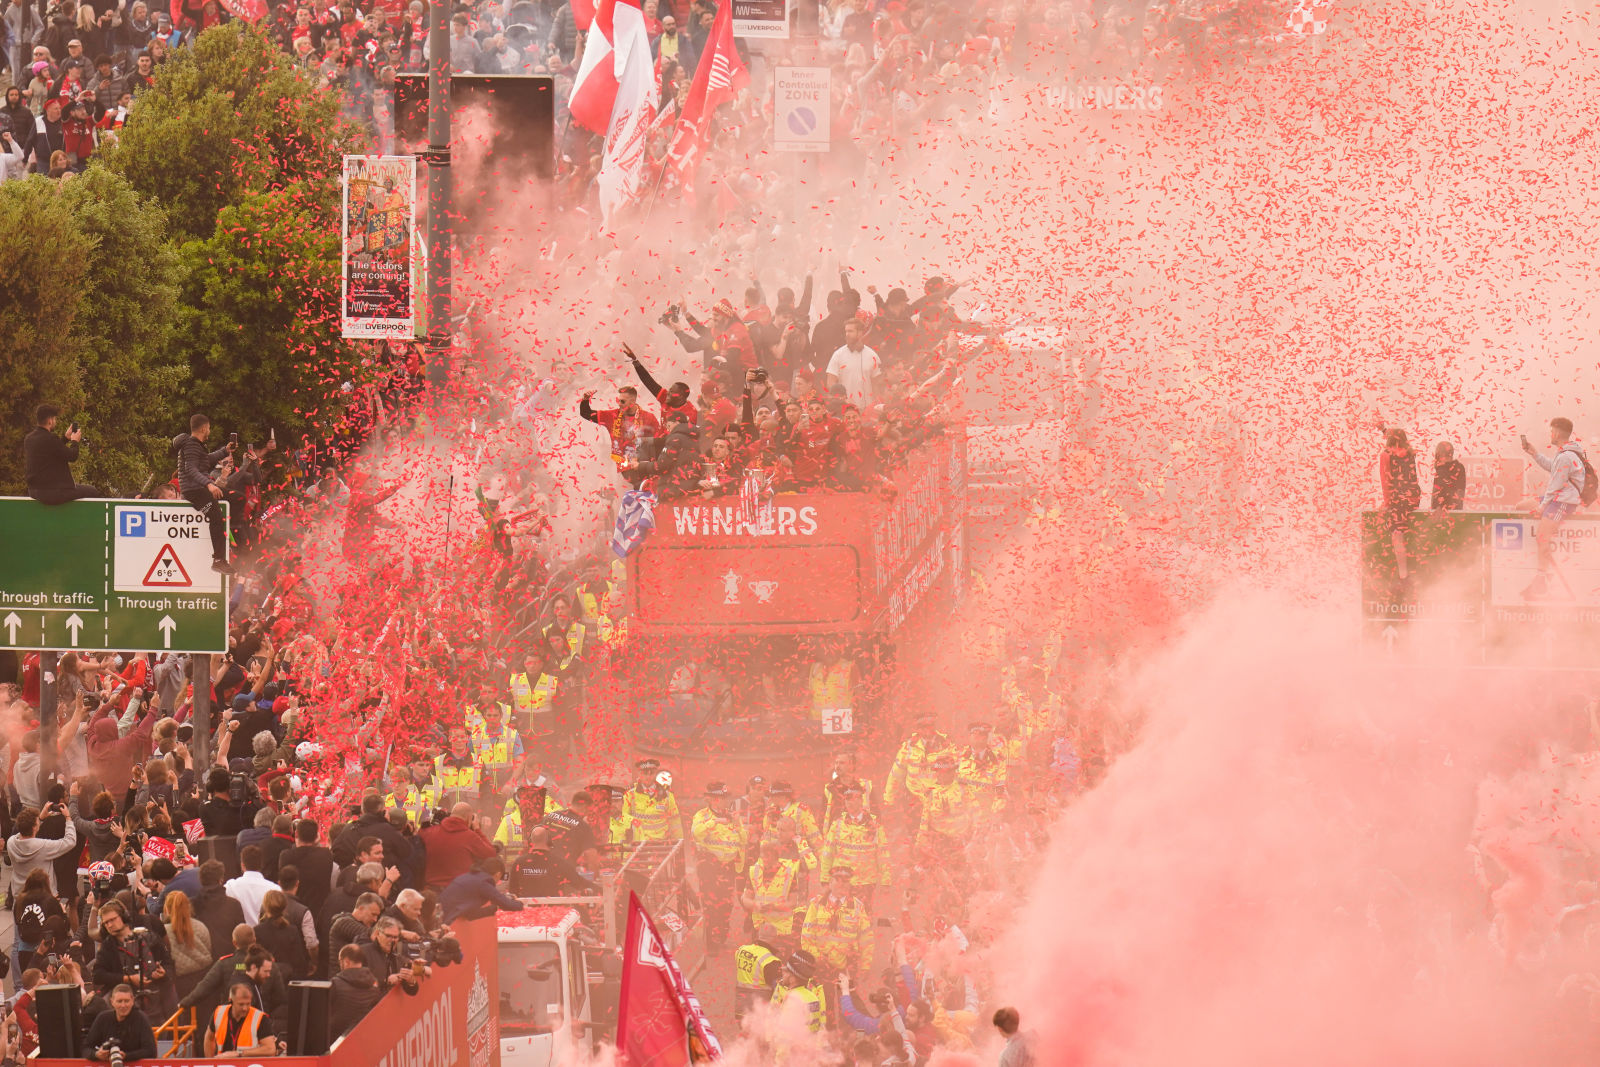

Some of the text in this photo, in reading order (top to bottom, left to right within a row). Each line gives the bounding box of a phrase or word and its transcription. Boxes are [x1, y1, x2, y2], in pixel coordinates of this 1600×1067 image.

[779, 81, 828, 89] Controlled
[785, 91, 820, 100] ZONE
[1045, 86, 1163, 110] WINNERS
[352, 261, 403, 270] The Tudors
[368, 272, 405, 281] coming!
[1466, 483, 1505, 499] OAD
[125, 514, 142, 534] P
[167, 527, 200, 539] ONE
[1502, 527, 1519, 547] P
[0, 591, 94, 605] hrough traffic
[118, 596, 218, 611] Through traffic
[1368, 600, 1425, 616] Through
